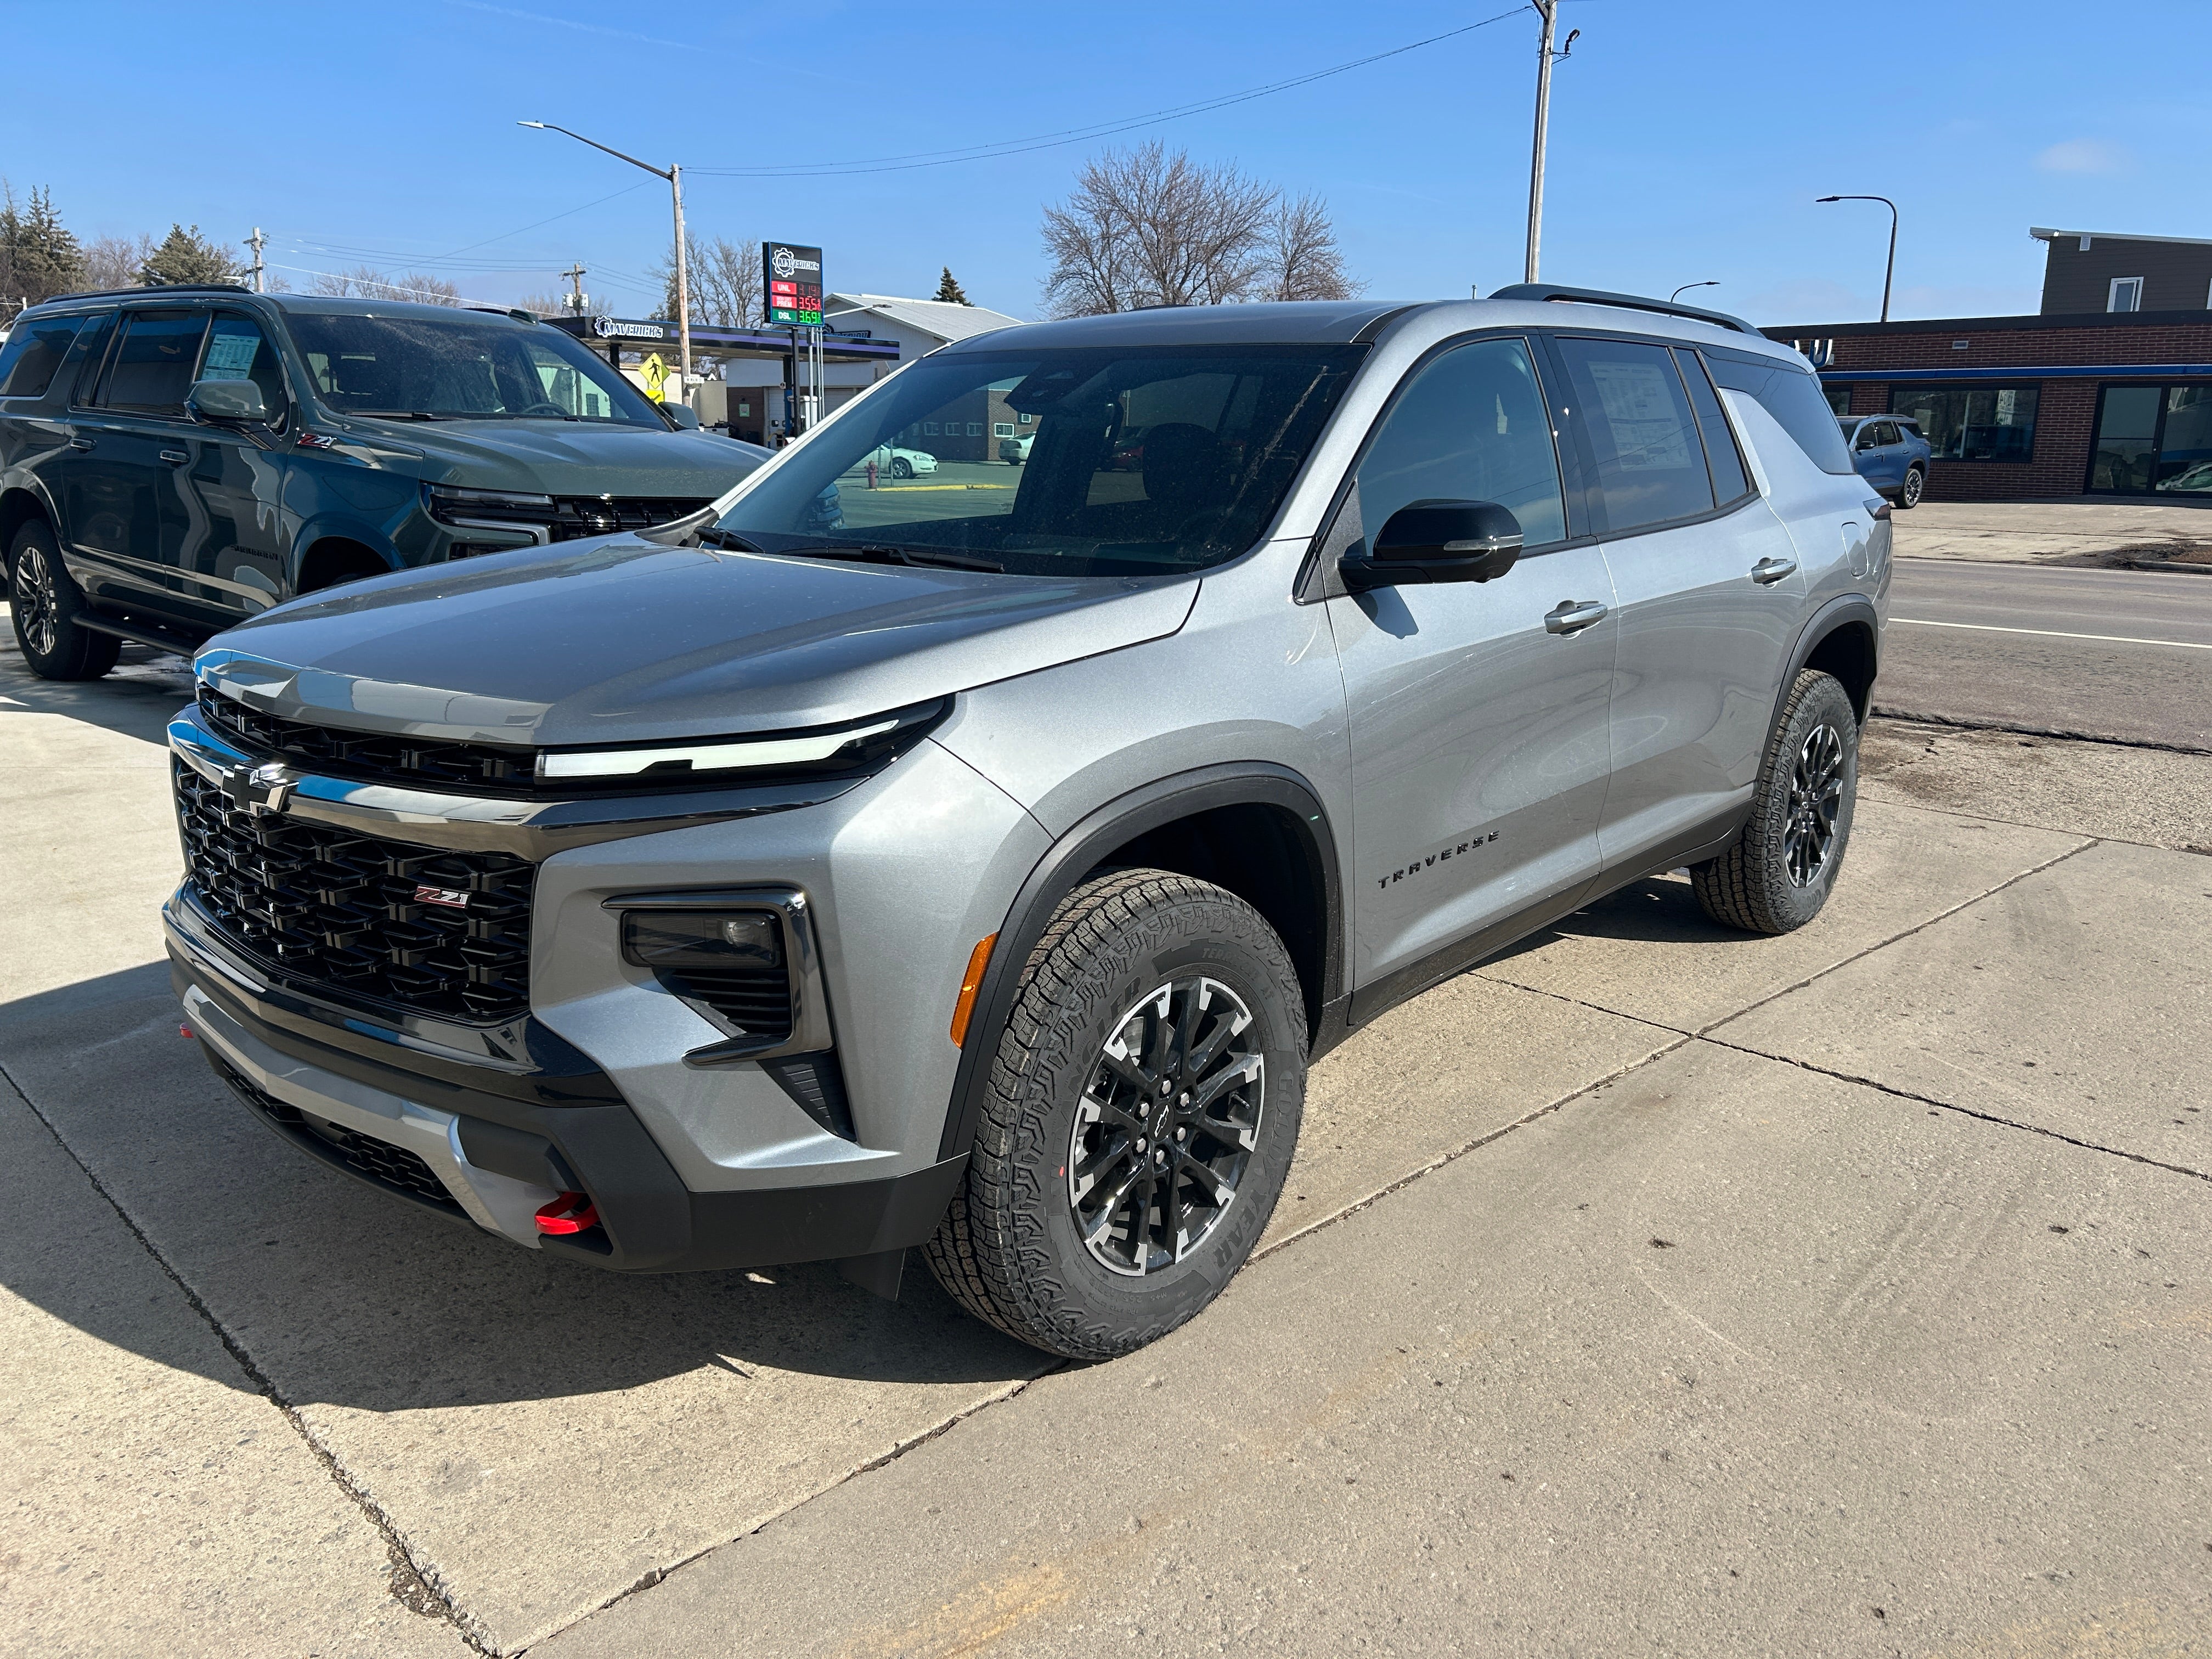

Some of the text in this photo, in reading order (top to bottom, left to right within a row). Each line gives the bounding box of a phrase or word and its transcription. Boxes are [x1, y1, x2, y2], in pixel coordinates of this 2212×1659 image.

[777, 284, 791, 292] UNL
[778, 311, 792, 320] DSL
[1378, 830, 1500, 889] TRAVERSE
[414, 886, 470, 909] Z71
[1212, 1070, 1294, 1268] GOODYEAR
